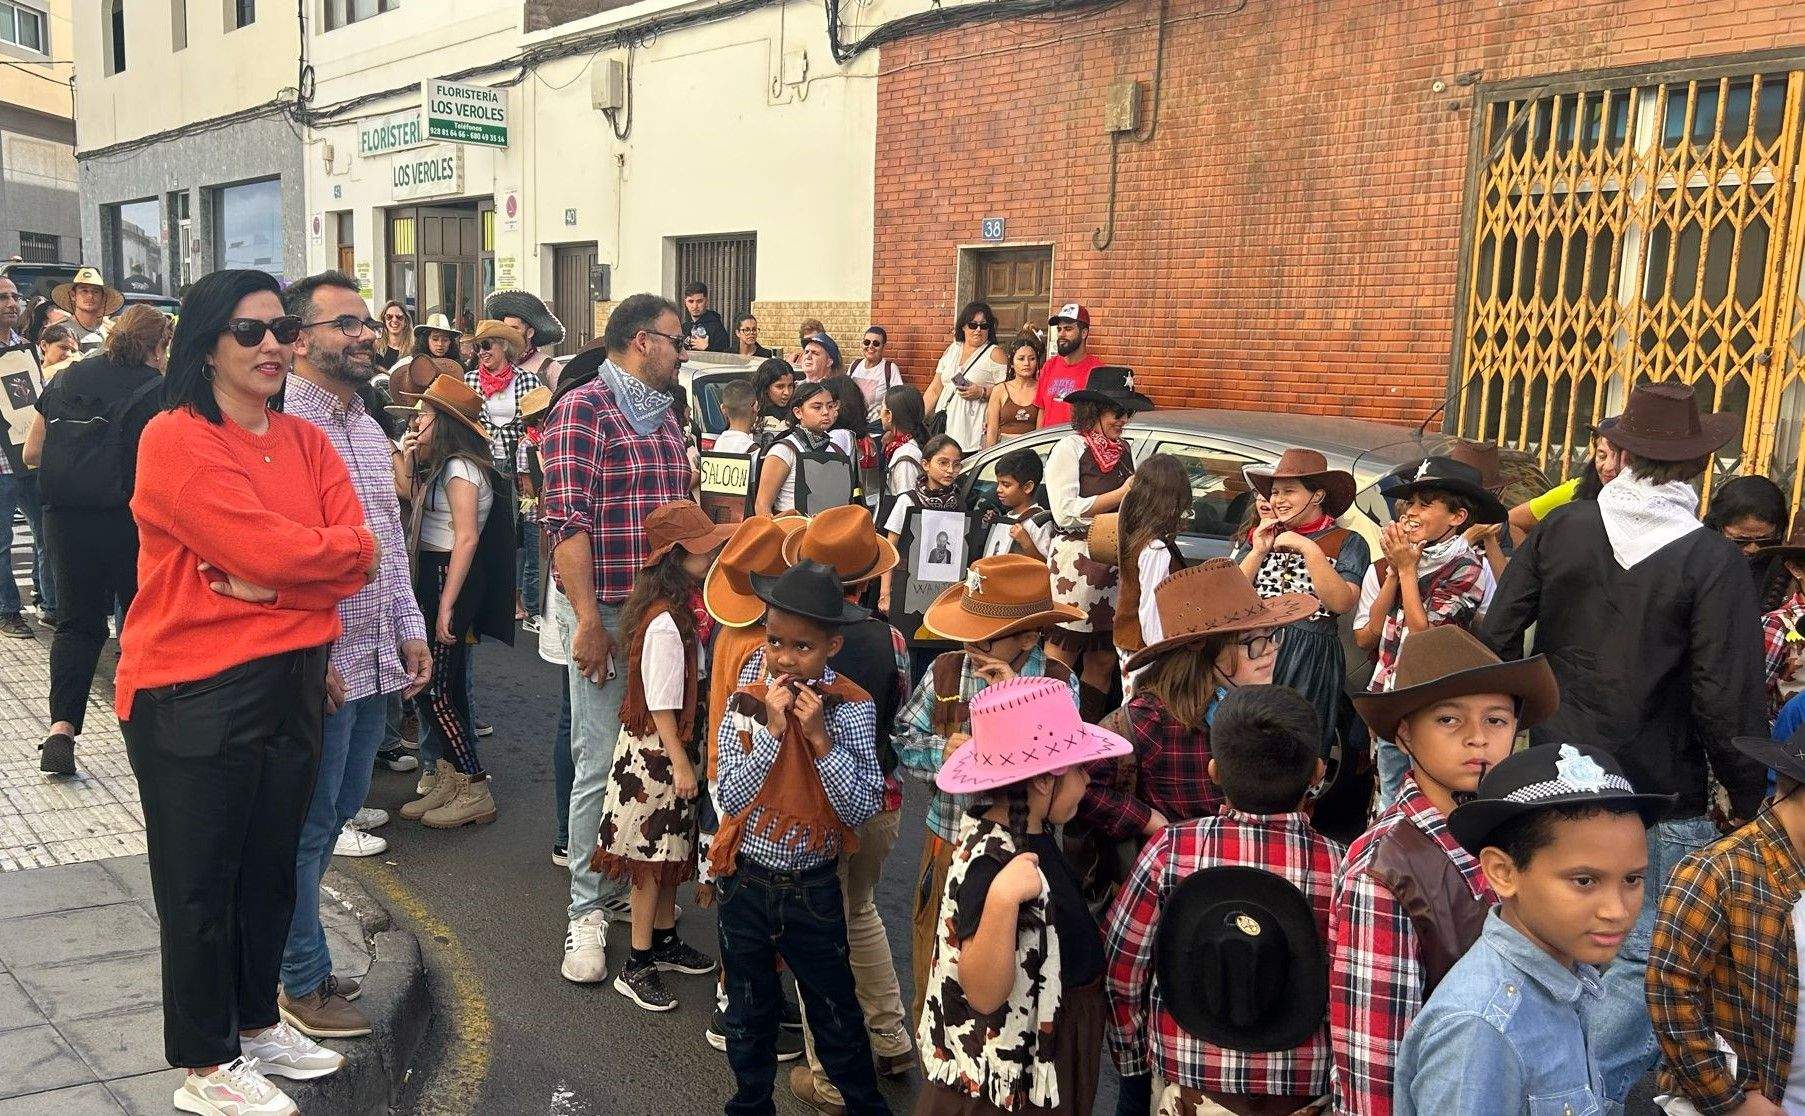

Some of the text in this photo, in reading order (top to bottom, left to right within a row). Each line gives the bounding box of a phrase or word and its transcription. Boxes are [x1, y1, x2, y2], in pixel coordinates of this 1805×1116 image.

[436, 85, 499, 104] FLORISTERÍA
[431, 99, 504, 122] LOS VEROLES
[361, 112, 423, 153] FLORISTERÍ
[429, 126, 441, 135] 928
[441, 128, 449, 136] 81
[453, 121, 483, 132] Teléfonos
[393, 156, 454, 187] LOS VEROLES
[984, 221, 1001, 237] 38
[701, 460, 748, 487] SALOON
